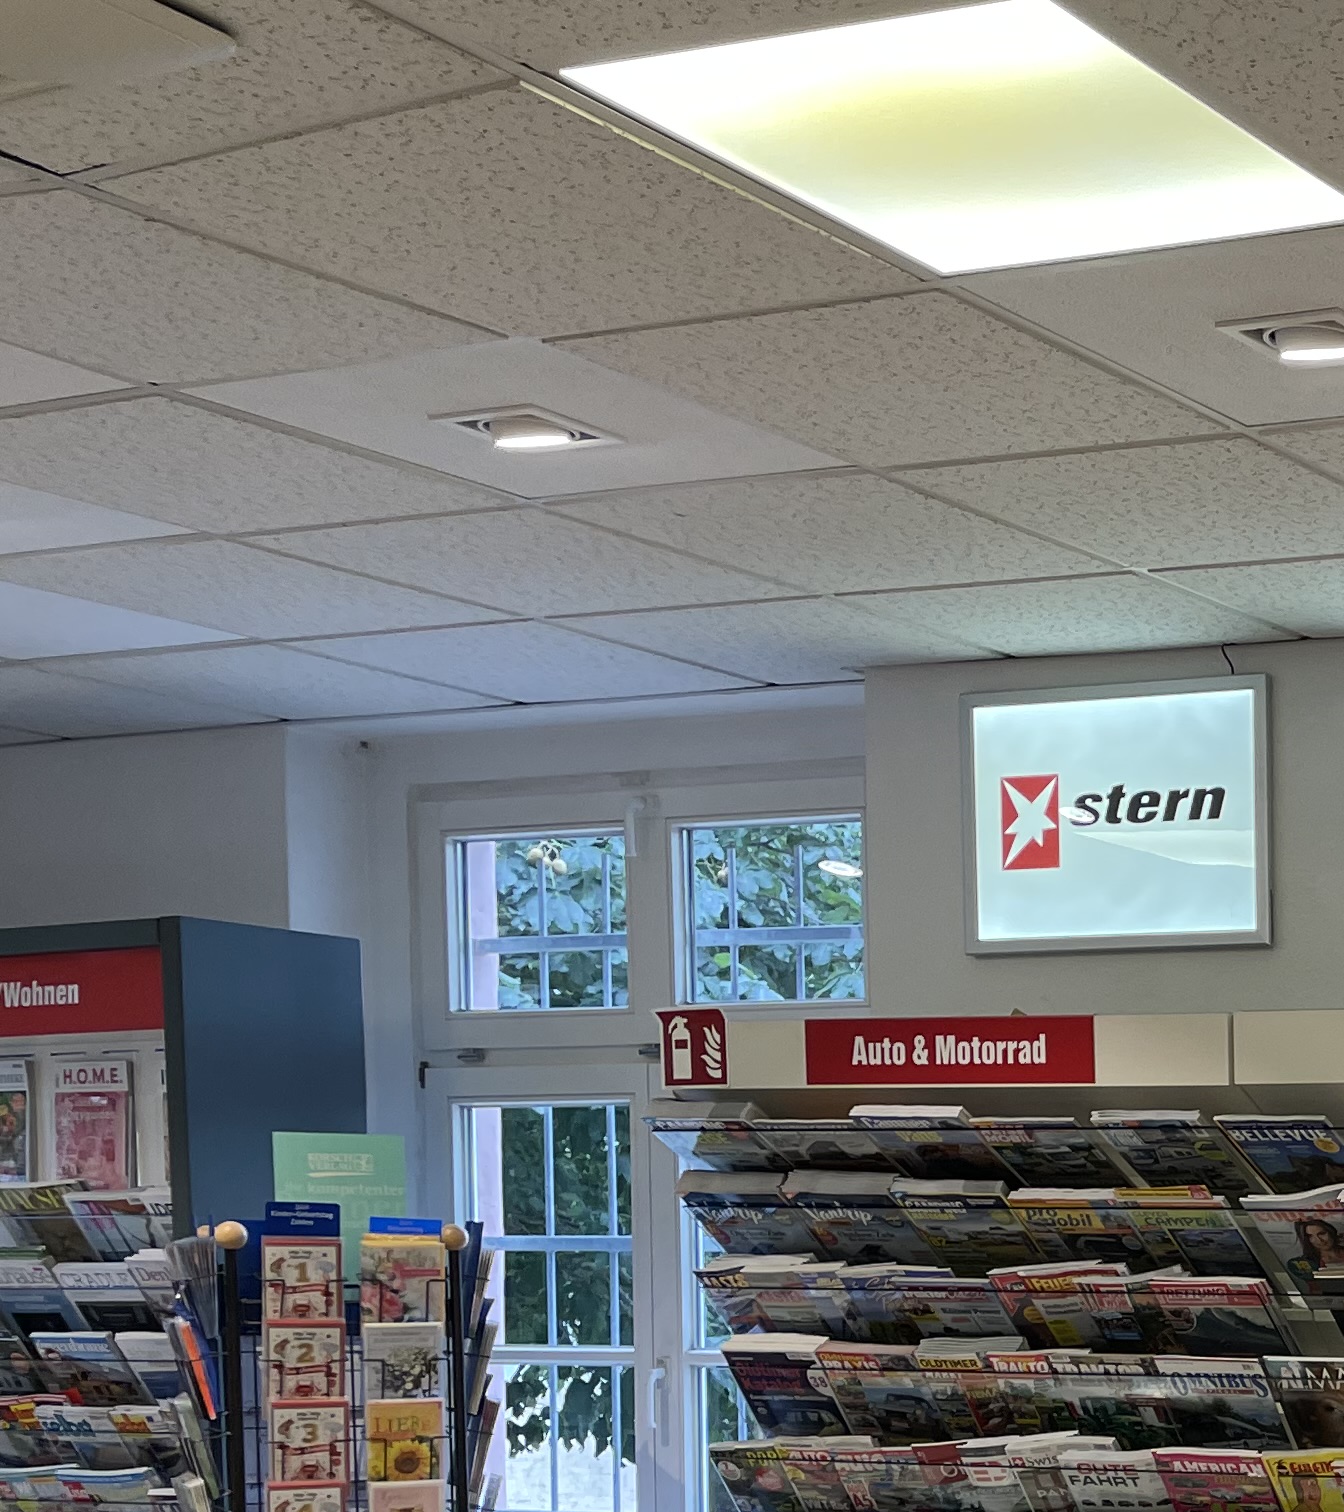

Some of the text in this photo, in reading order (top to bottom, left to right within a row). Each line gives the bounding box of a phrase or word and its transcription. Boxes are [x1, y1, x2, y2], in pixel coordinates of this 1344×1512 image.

[1070, 778, 1226, 828] stern
[852, 1033, 1046, 1066] Auto & Motorrad
[62, 1066, 123, 1087] H.O.M.E.
[919, 1357, 980, 1370] OLDTIMER
[1172, 1461, 1263, 1475] AMERICAN
[1067, 1472, 1141, 1488] FAHRT
